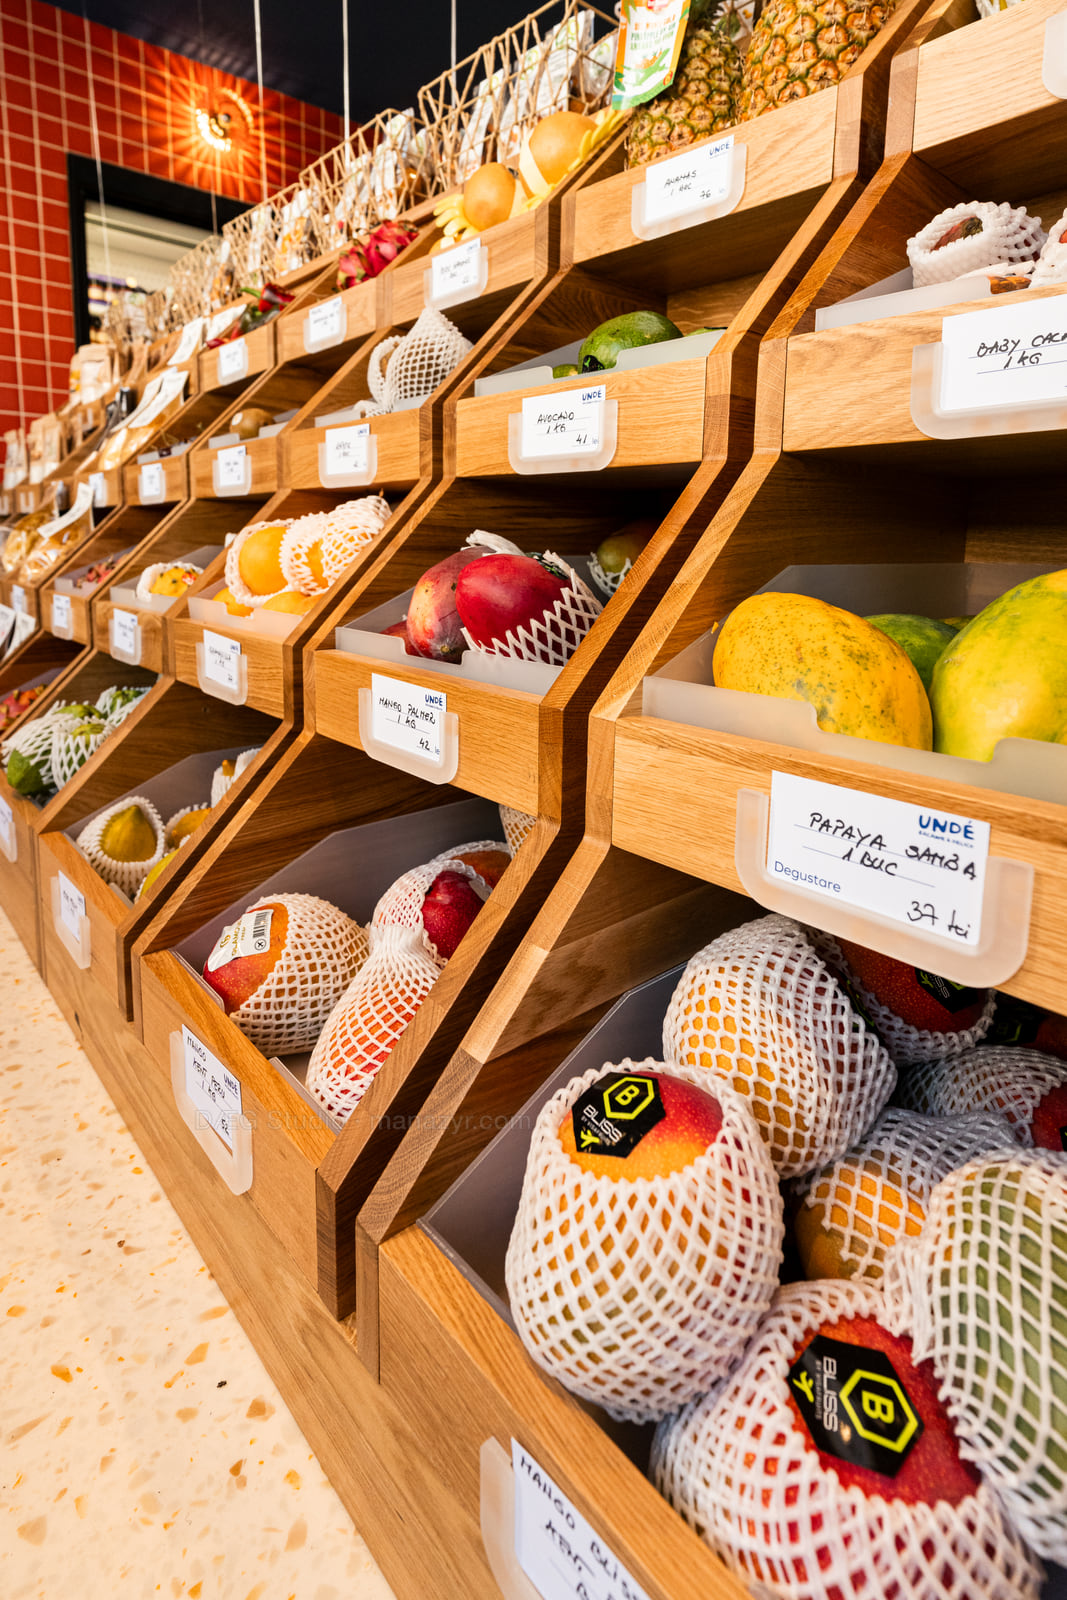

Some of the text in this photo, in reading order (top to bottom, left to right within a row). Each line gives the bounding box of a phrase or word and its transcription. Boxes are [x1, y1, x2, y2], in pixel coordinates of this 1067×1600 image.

[977, 338, 1021, 357] BABY
[1003, 350, 1042, 370] 1 KG
[537, 411, 575, 424] AVOCADO
[546, 426, 551, 434] 1
[576, 434, 588, 444] 41
[379, 697, 436, 725] MANGO PALMER
[425, 694, 443, 706] UNDÉ
[397, 715, 416, 729] 1 KG
[420, 738, 430, 751] 42
[918, 815, 975, 840] UNDÉ
[810, 812, 977, 880] PAPAYA SAMBA
[842, 848, 898, 877] 1 BUC
[774, 860, 841, 893] Degustare
[907, 901, 939, 926] 37
[615, 1084, 640, 1105] B
[583, 1104, 622, 1143] BLISS
[823, 1356, 838, 1432] BLISS
[862, 1390, 895, 1424] B
[520, 1455, 575, 1530] MANGO
